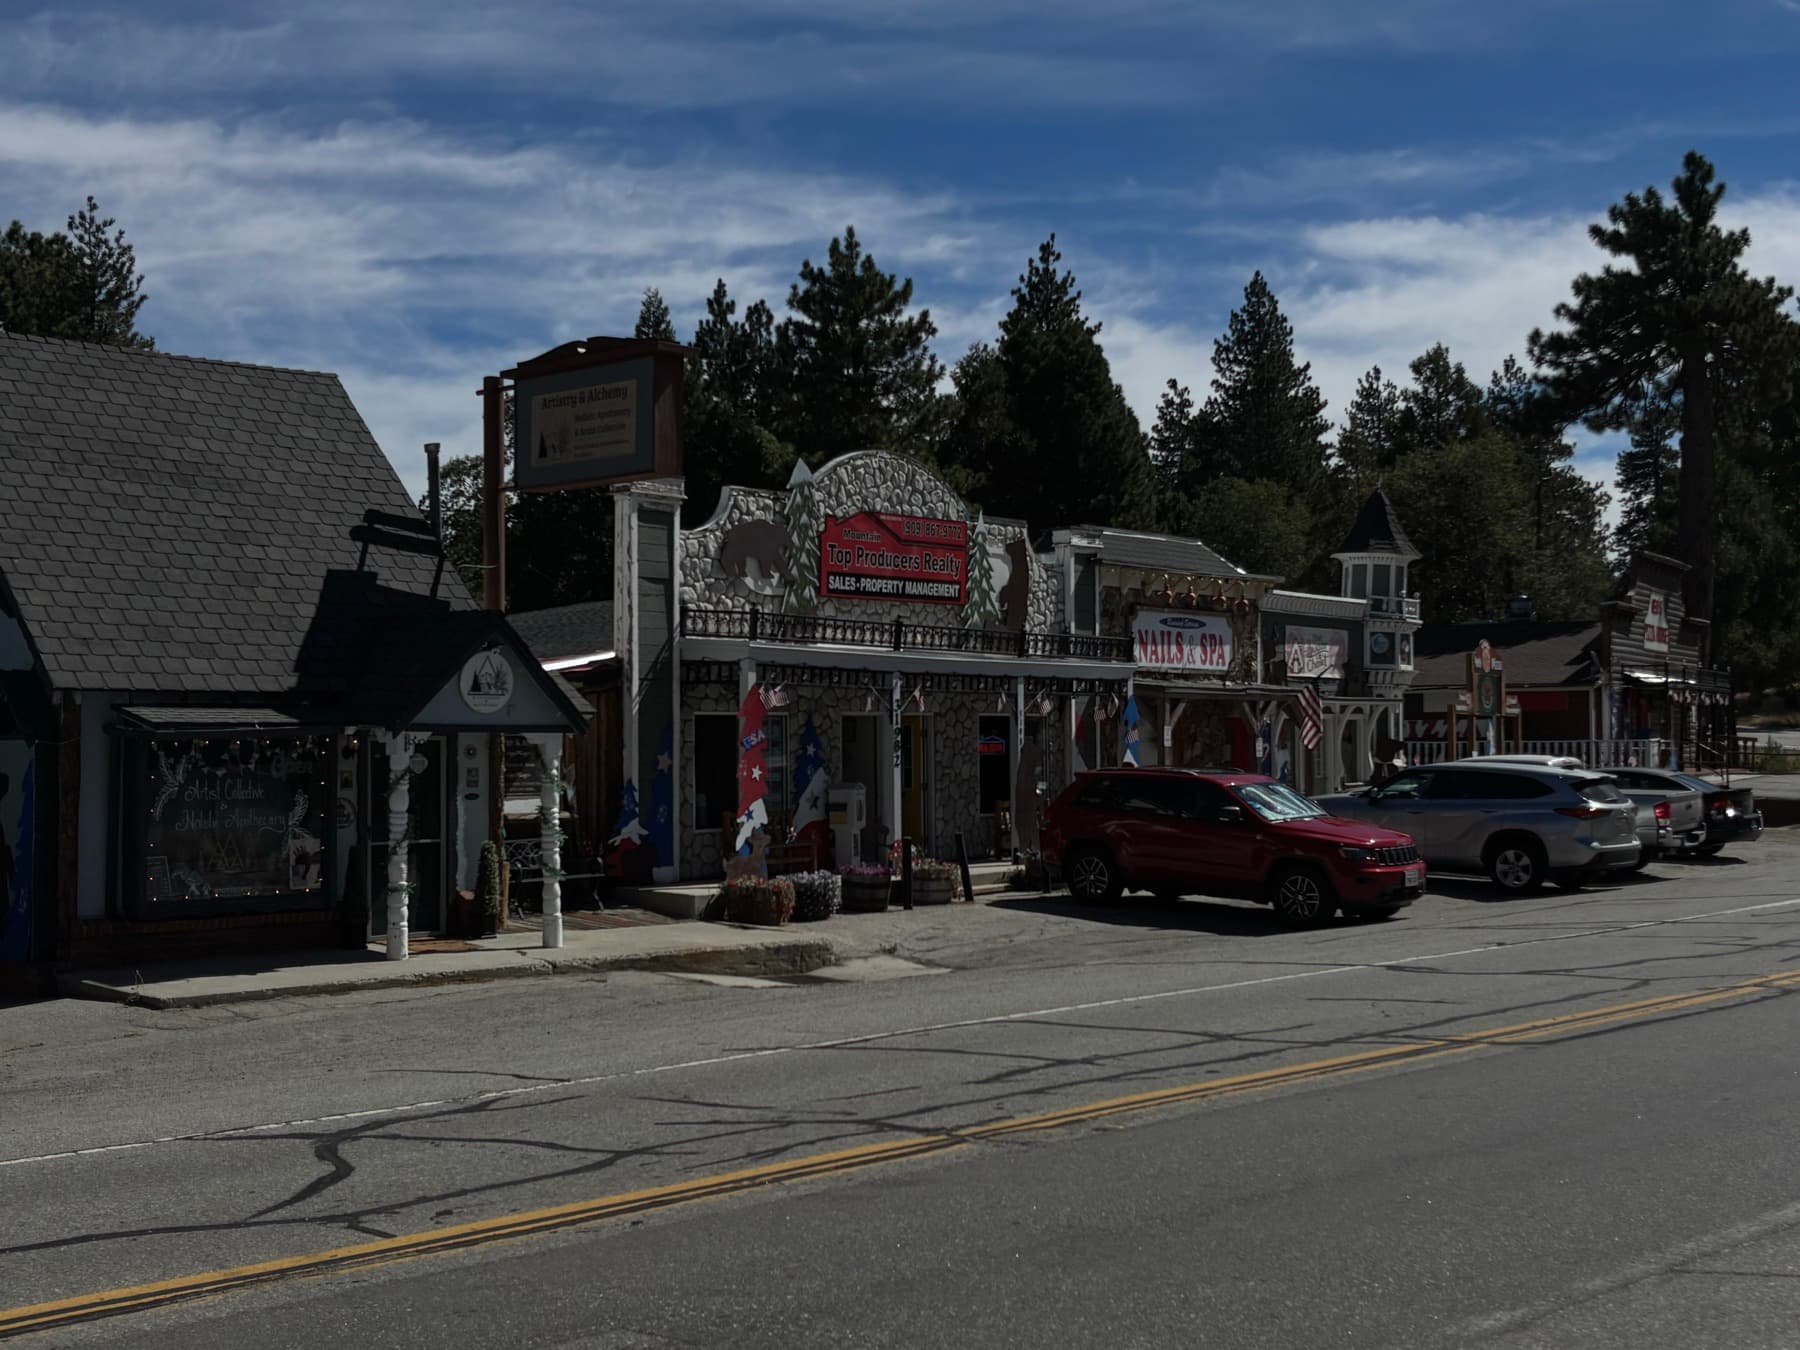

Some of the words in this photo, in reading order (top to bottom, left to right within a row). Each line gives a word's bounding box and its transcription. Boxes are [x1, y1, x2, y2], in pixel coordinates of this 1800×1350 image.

[542, 396, 577, 409] Artistry
[589, 386, 628, 402] Alchemy
[842, 528, 881, 543] Mountain
[827, 543, 852, 570] Top
[856, 545, 920, 571] Producers
[923, 551, 962, 579] Realty
[905, 580, 961, 599] MANAGEMENT
[1137, 629, 1184, 665] NAILS
[1187, 634, 1196, 666] &
[1200, 632, 1227, 668] SPA
